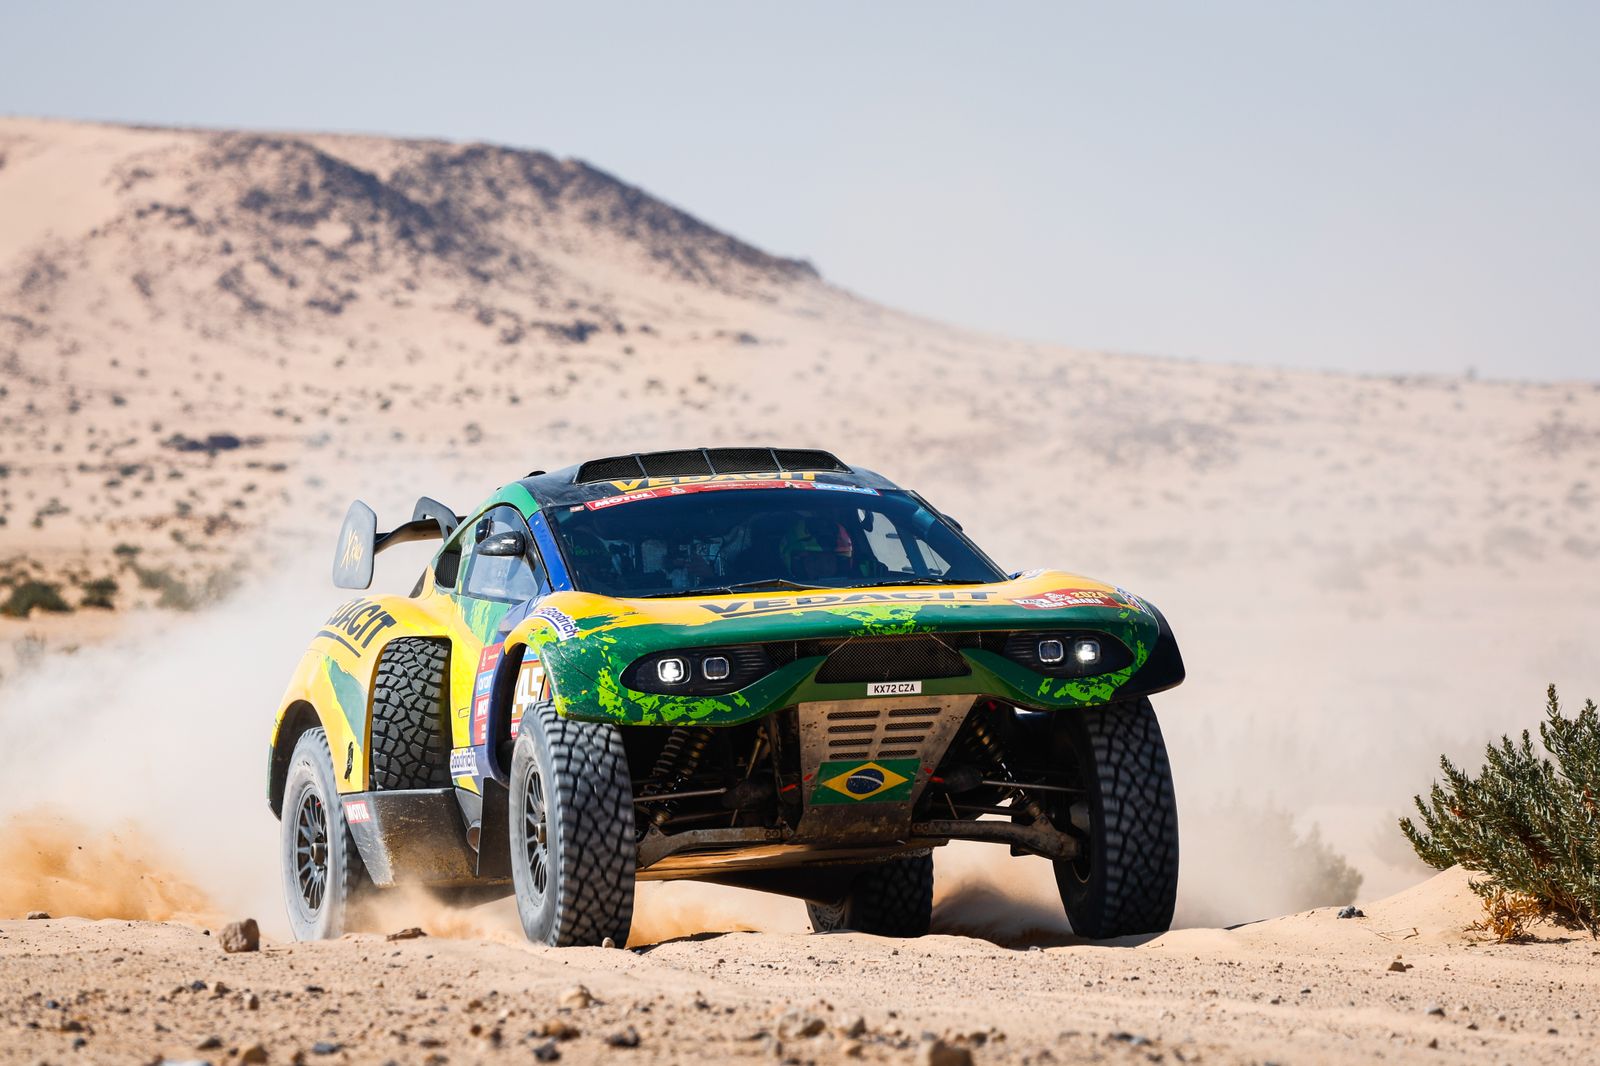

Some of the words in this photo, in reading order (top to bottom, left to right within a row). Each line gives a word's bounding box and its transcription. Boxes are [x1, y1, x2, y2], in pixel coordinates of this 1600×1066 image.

[594, 493, 652, 508] MOTUL
[700, 591, 997, 614] VEDACIT
[1070, 591, 1108, 600] 2024
[325, 598, 397, 649] DACIT
[534, 607, 578, 637] Goodrich
[873, 684, 897, 694] KX72
[898, 683, 915, 692] CZA
[346, 803, 370, 820] MOTUL
